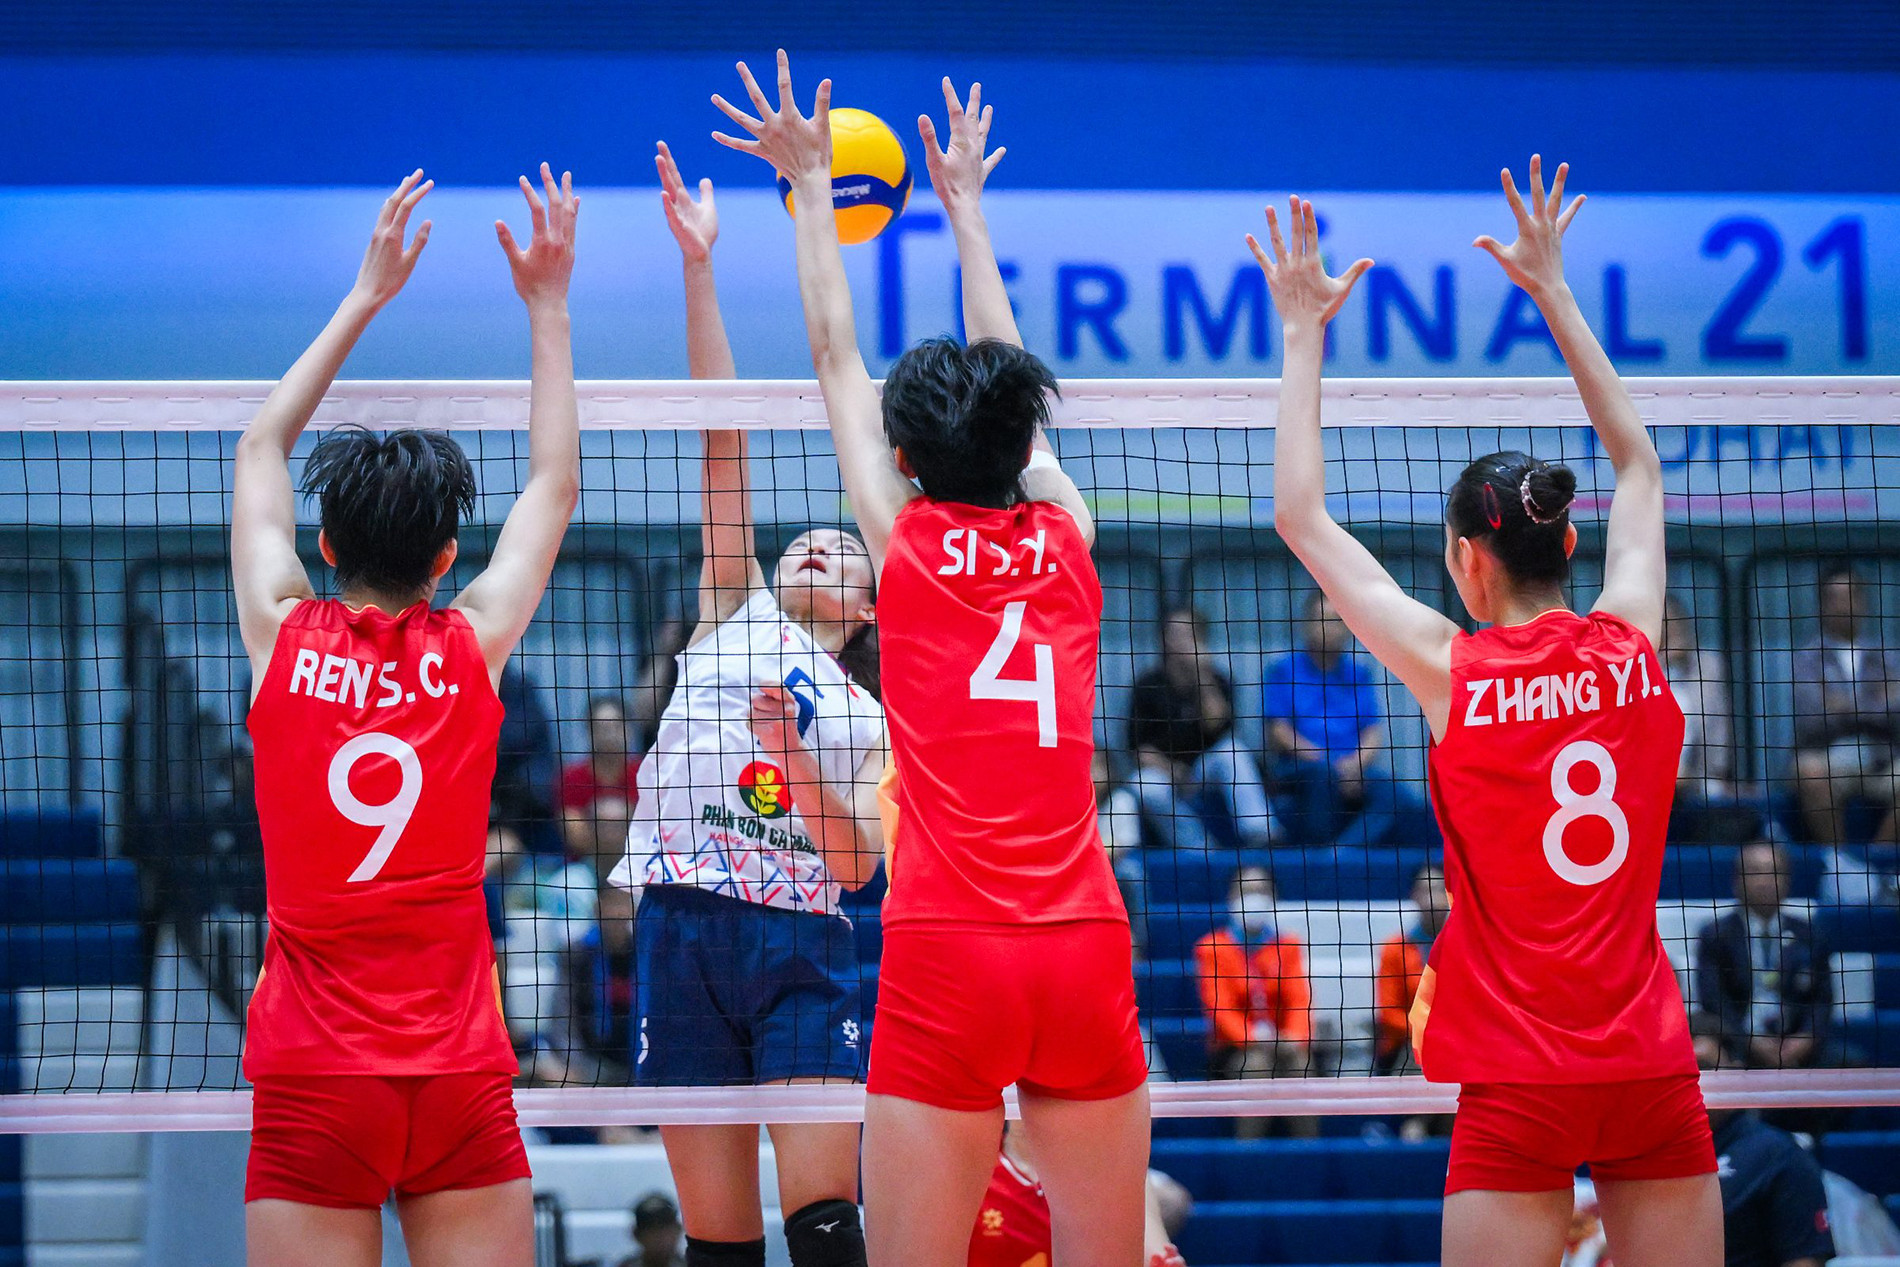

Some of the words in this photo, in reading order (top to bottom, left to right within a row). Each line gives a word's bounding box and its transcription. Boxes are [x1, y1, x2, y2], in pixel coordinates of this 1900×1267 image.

[1700, 213, 1870, 362] 21
[937, 529, 978, 576] SI
[289, 648, 375, 709] REN
[969, 600, 1058, 748] 4
[1463, 670, 1600, 727] ZHANG
[327, 731, 423, 883] 9
[1541, 740, 1630, 886] 8
